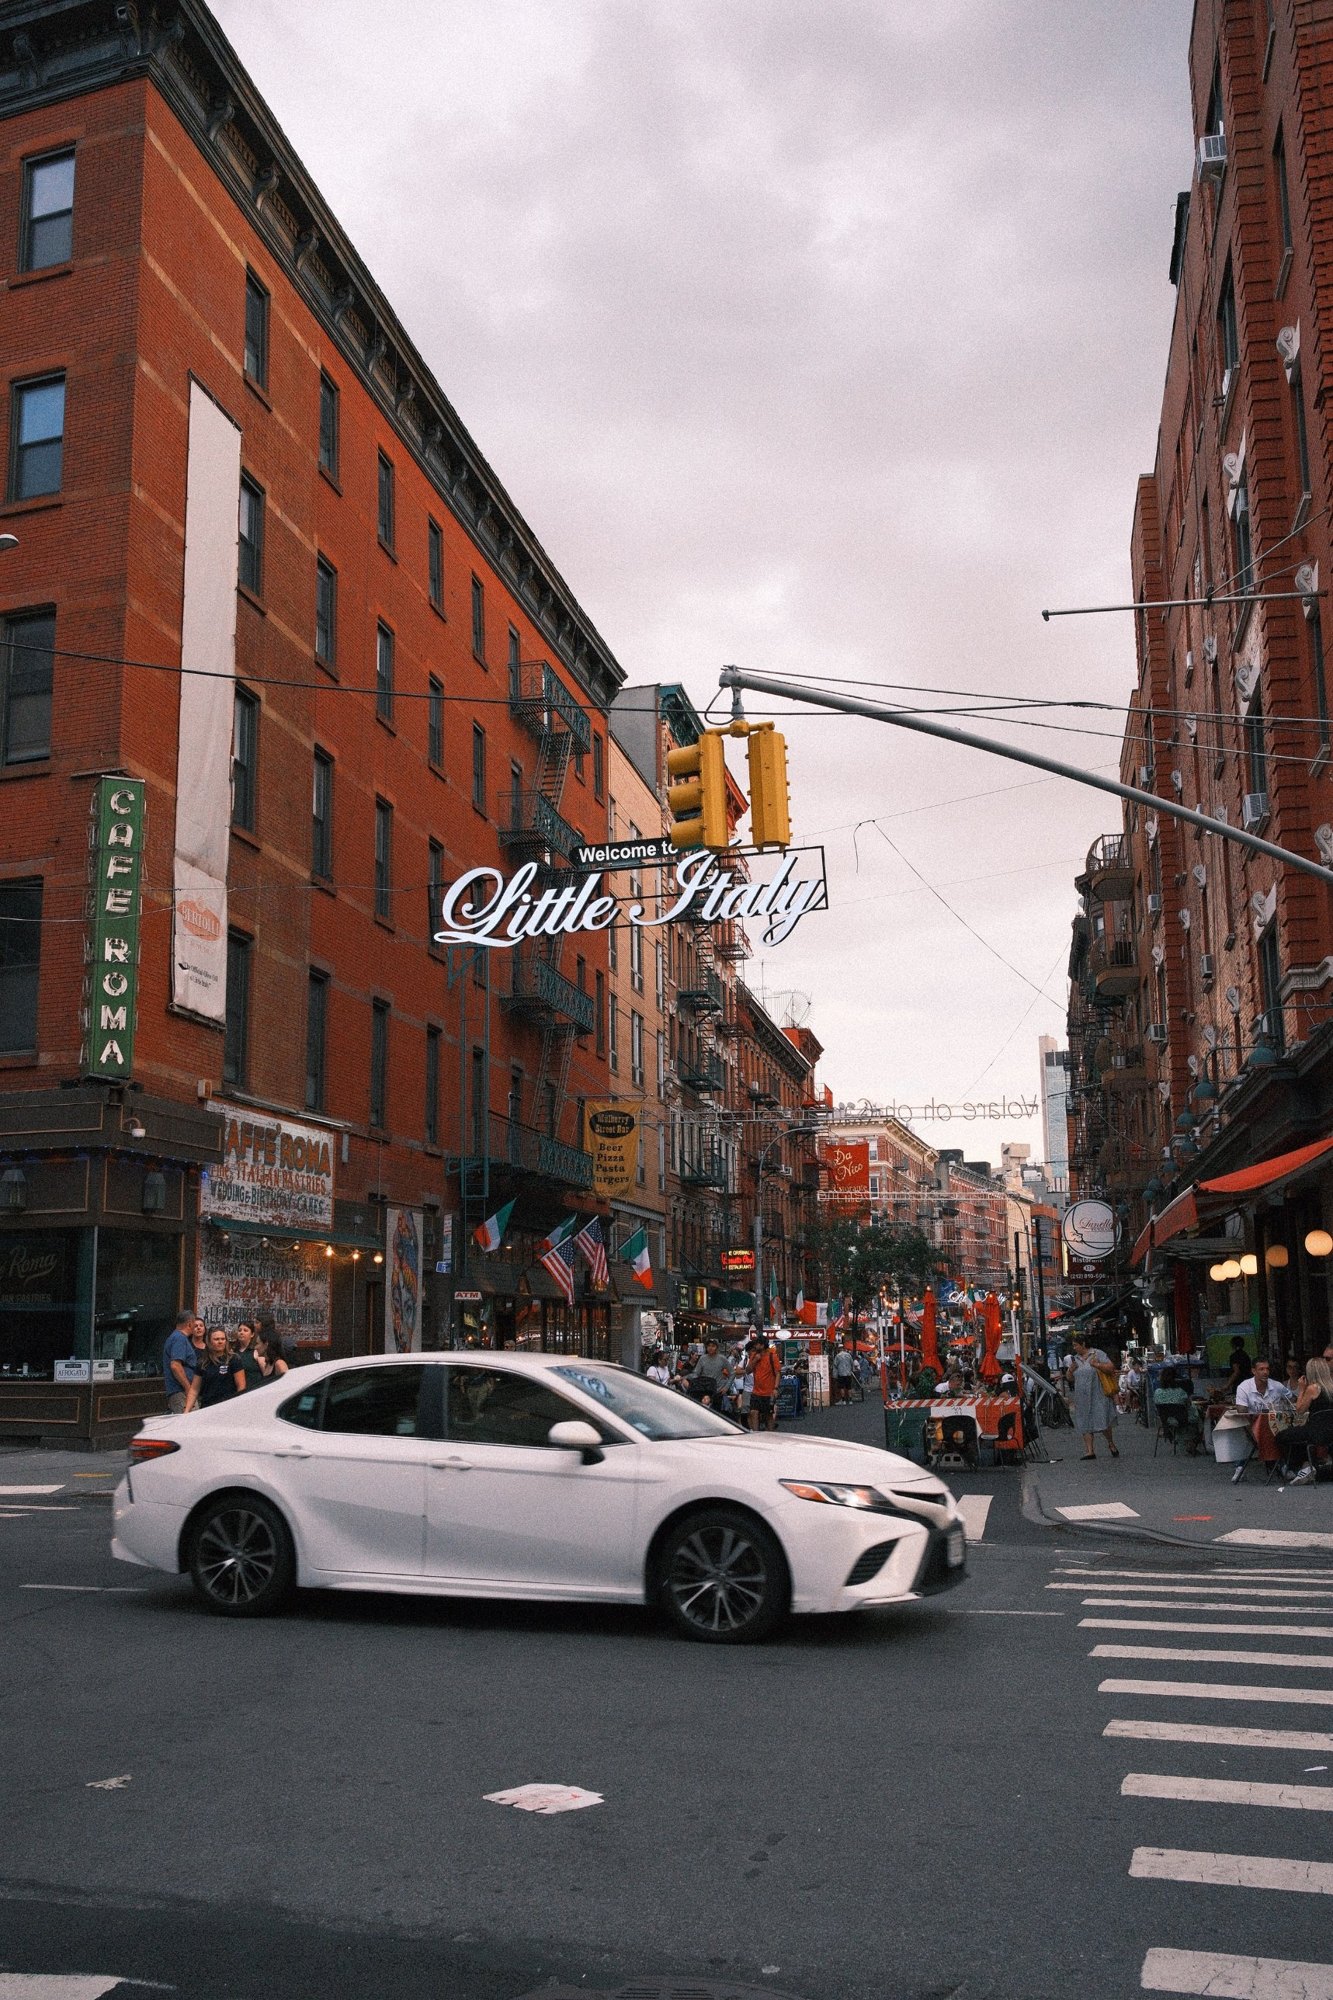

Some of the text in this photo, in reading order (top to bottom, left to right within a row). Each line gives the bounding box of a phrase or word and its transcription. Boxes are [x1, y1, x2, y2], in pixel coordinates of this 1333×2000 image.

[578, 840, 680, 864] Welcome to
[434, 838, 826, 948] Little Italy
[100, 789, 135, 1066] CAFE ROMA
[181, 904, 220, 935] BERTOLLI
[281, 1132, 331, 1178] ROMA
[597, 1153, 624, 1161] Pizza
[599, 1143, 623, 1151] Beer
[833, 1149, 852, 1166] Da
[595, 1164, 625, 1172] Pasta
[596, 1175, 629, 1185] urgers
[835, 1162, 864, 1182] Nico
[282, 1168, 326, 1196] PASTRIES
[9, 1247, 58, 1286] Roma
